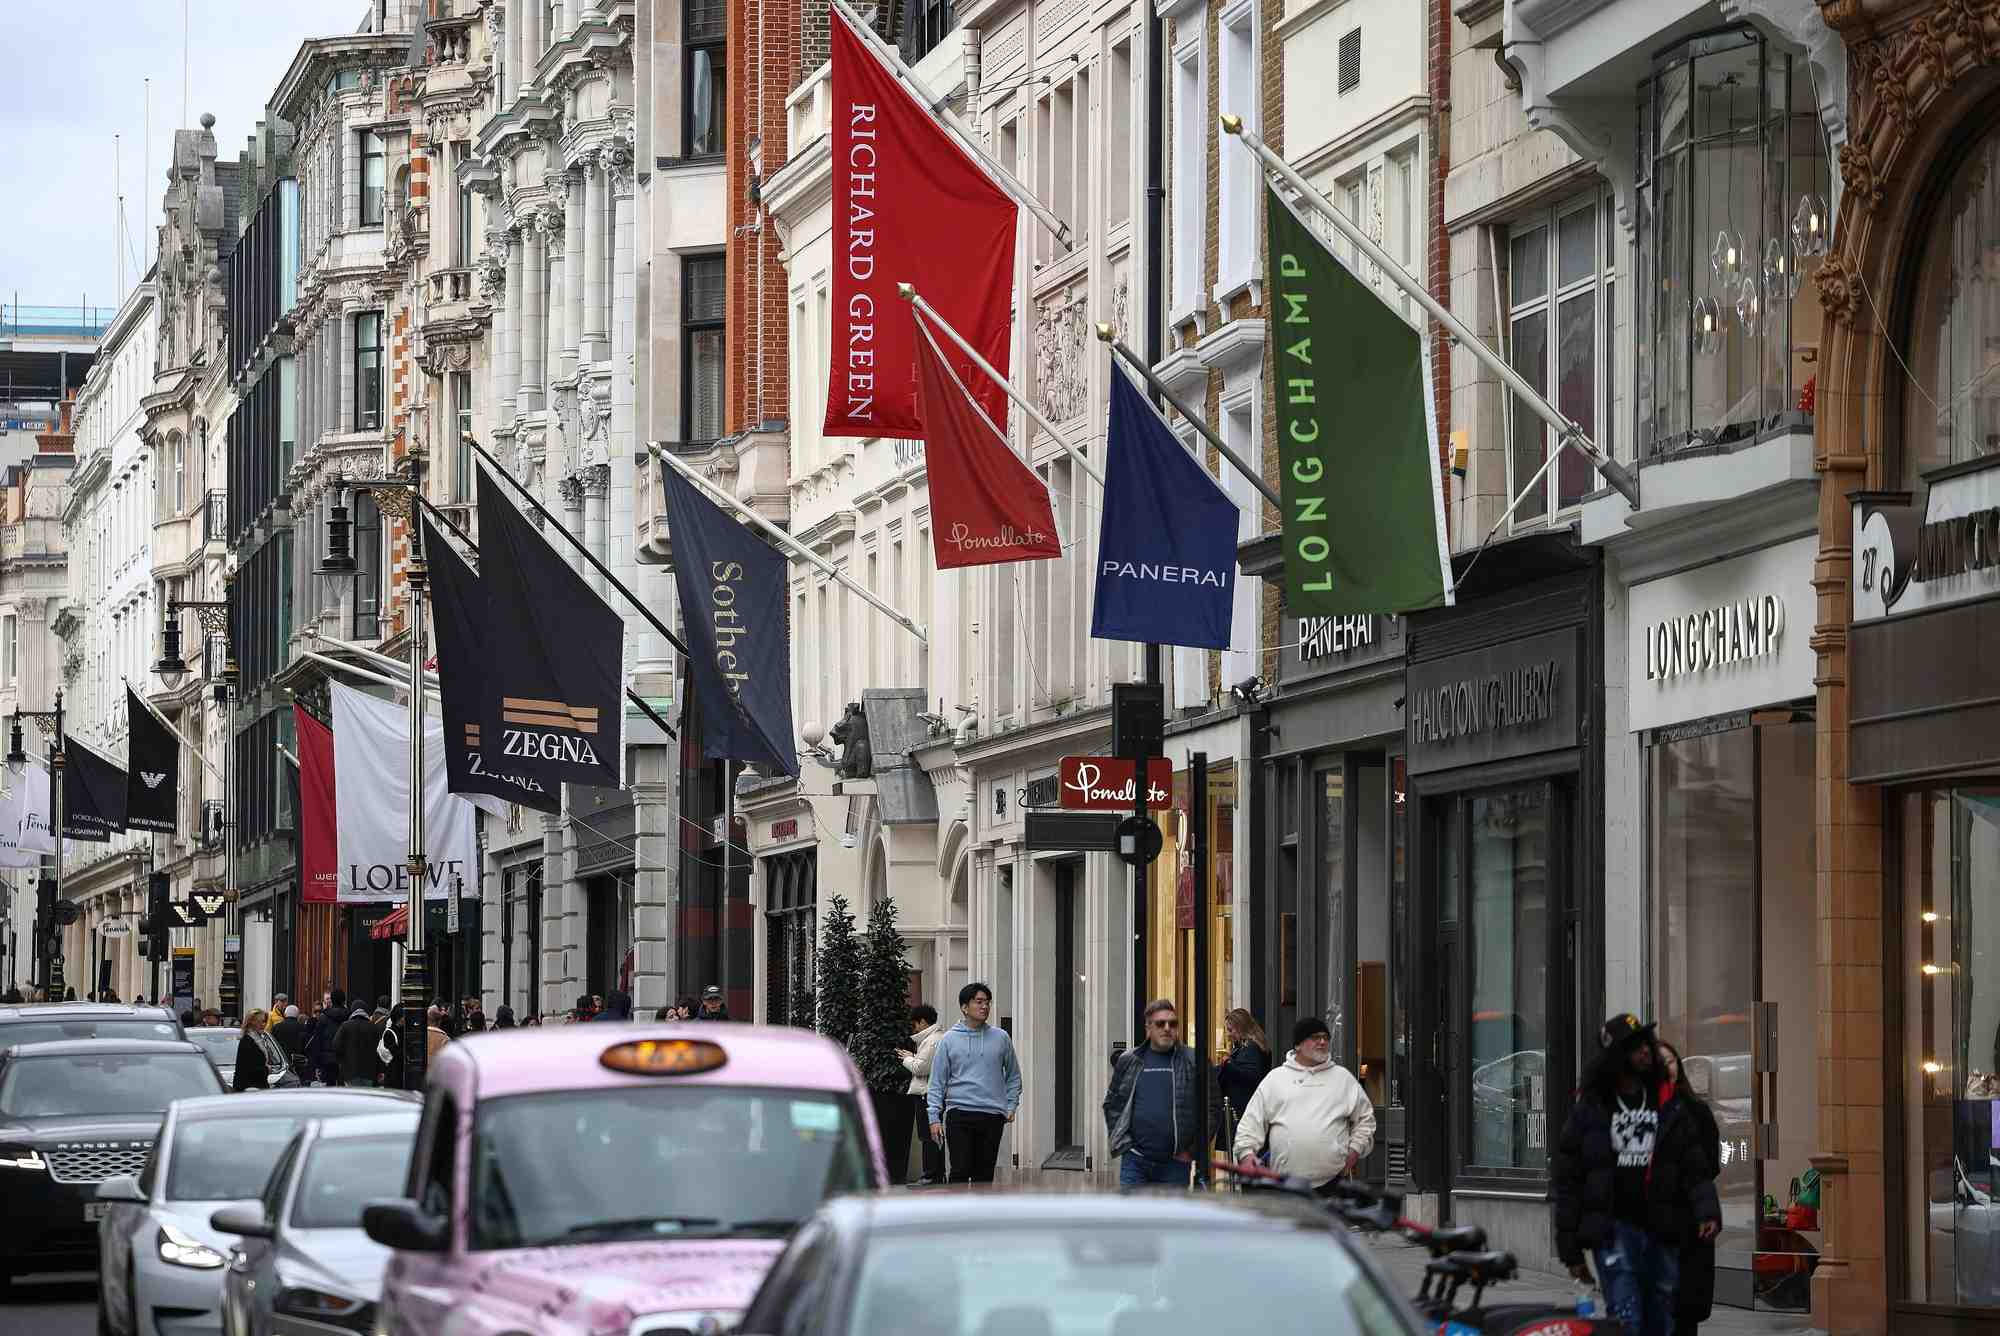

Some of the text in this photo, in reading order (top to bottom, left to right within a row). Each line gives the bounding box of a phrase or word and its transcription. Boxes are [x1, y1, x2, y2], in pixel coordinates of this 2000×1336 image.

[847, 103, 877, 421] RICHARD GREEN
[1280, 253, 1333, 592] LONGCHAMP
[945, 521, 1047, 552] Pomellato
[1102, 560, 1227, 588] PANERAI
[1862, 546, 1878, 593] 27
[1298, 613, 1373, 661] PANERAI
[1646, 595, 1781, 681] LONGCHAMP
[1411, 659, 1557, 745] HALCYON GALLERY
[502, 729, 601, 766] ZEGNA
[1064, 761, 1169, 804] Pomellto
